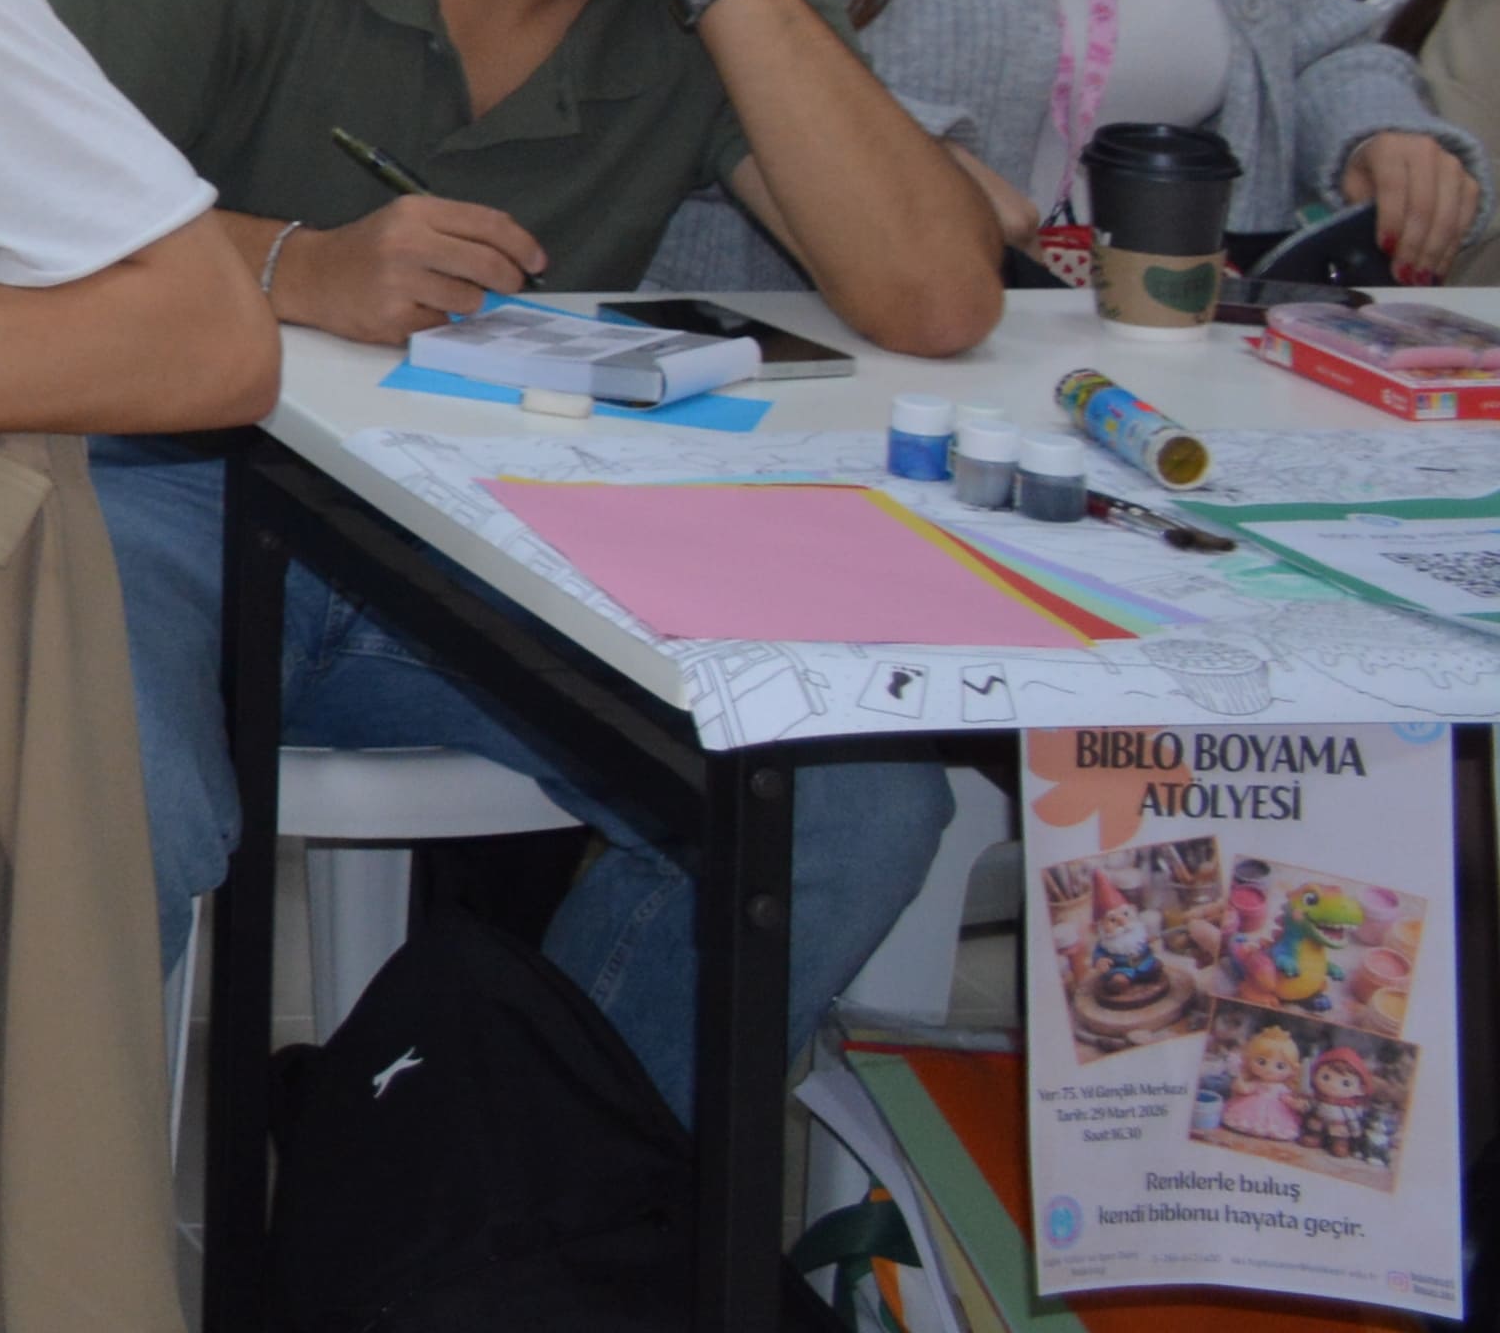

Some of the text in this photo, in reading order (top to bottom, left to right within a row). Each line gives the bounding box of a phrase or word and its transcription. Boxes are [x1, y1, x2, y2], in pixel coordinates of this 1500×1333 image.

[1193, 732, 1366, 776] BOYAMA
[1137, 778, 1302, 820] ATÖLYESİ
[1146, 1171, 1301, 1202] Renklerle buluş
[1098, 1204, 1365, 1239] kendi biblonu hayata geçir.
